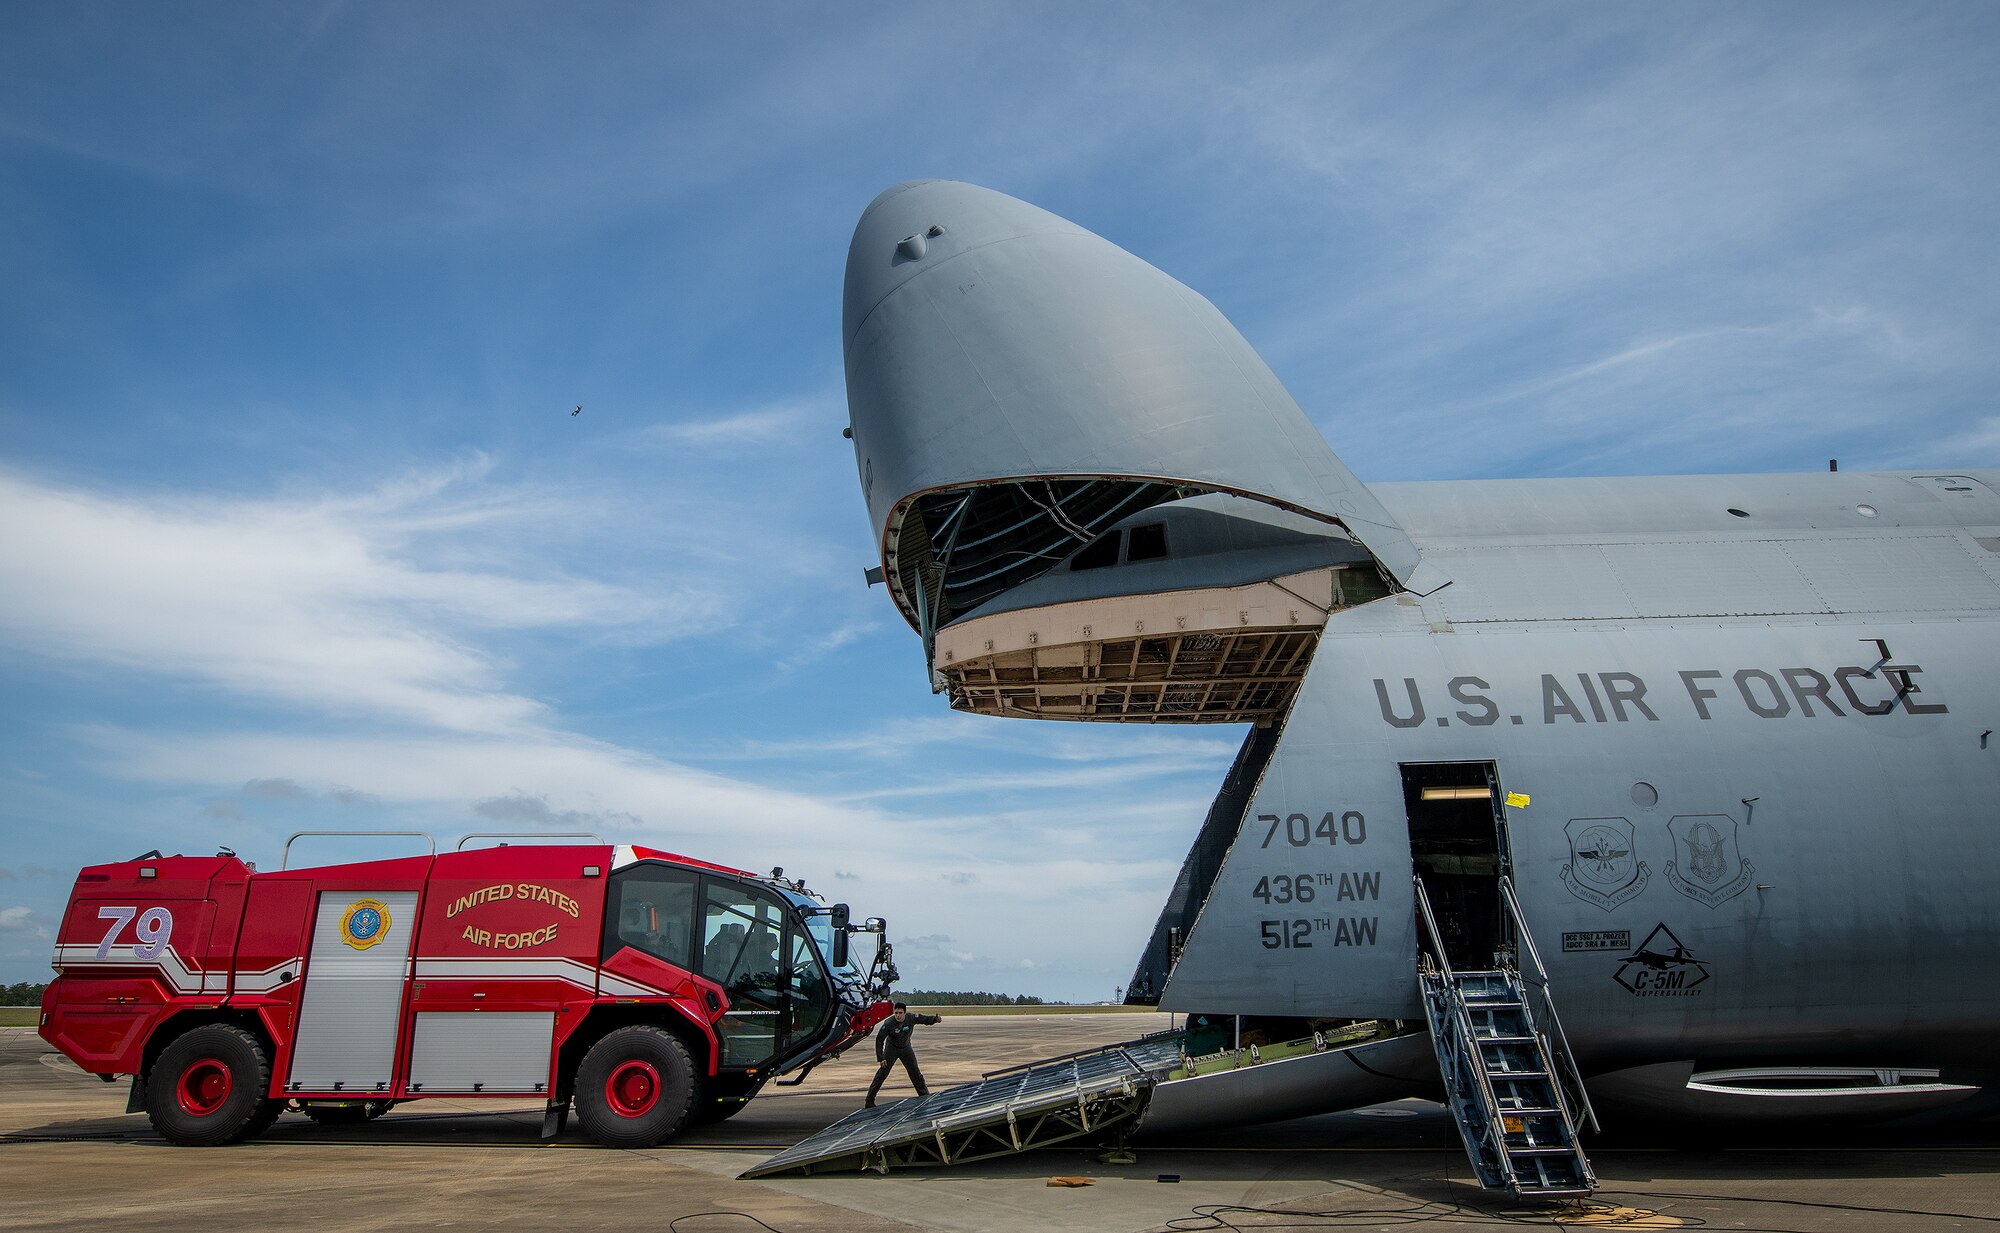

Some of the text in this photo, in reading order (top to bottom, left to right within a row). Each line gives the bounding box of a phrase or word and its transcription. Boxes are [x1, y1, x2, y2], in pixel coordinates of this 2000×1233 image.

[1373, 665, 1950, 728] U.S. AIR FORCE
[1257, 810, 1367, 848] 7040
[1252, 871, 1381, 905] 436TH AW
[1567, 877, 1646, 907] AIR MOBILITY COMMAND
[1725, 870, 1749, 896] COMMAND
[446, 882, 580, 919] UNITED STATES
[95, 905, 173, 961] 79
[461, 922, 559, 951] AIR FORCE
[1261, 916, 1378, 950] 512TH AW
[1585, 940, 1598, 948] SRA
[1610, 939, 1628, 947] MESA
[1634, 970, 1686, 989] C-5M
[1635, 989, 1702, 997] SUPERGALAXY
